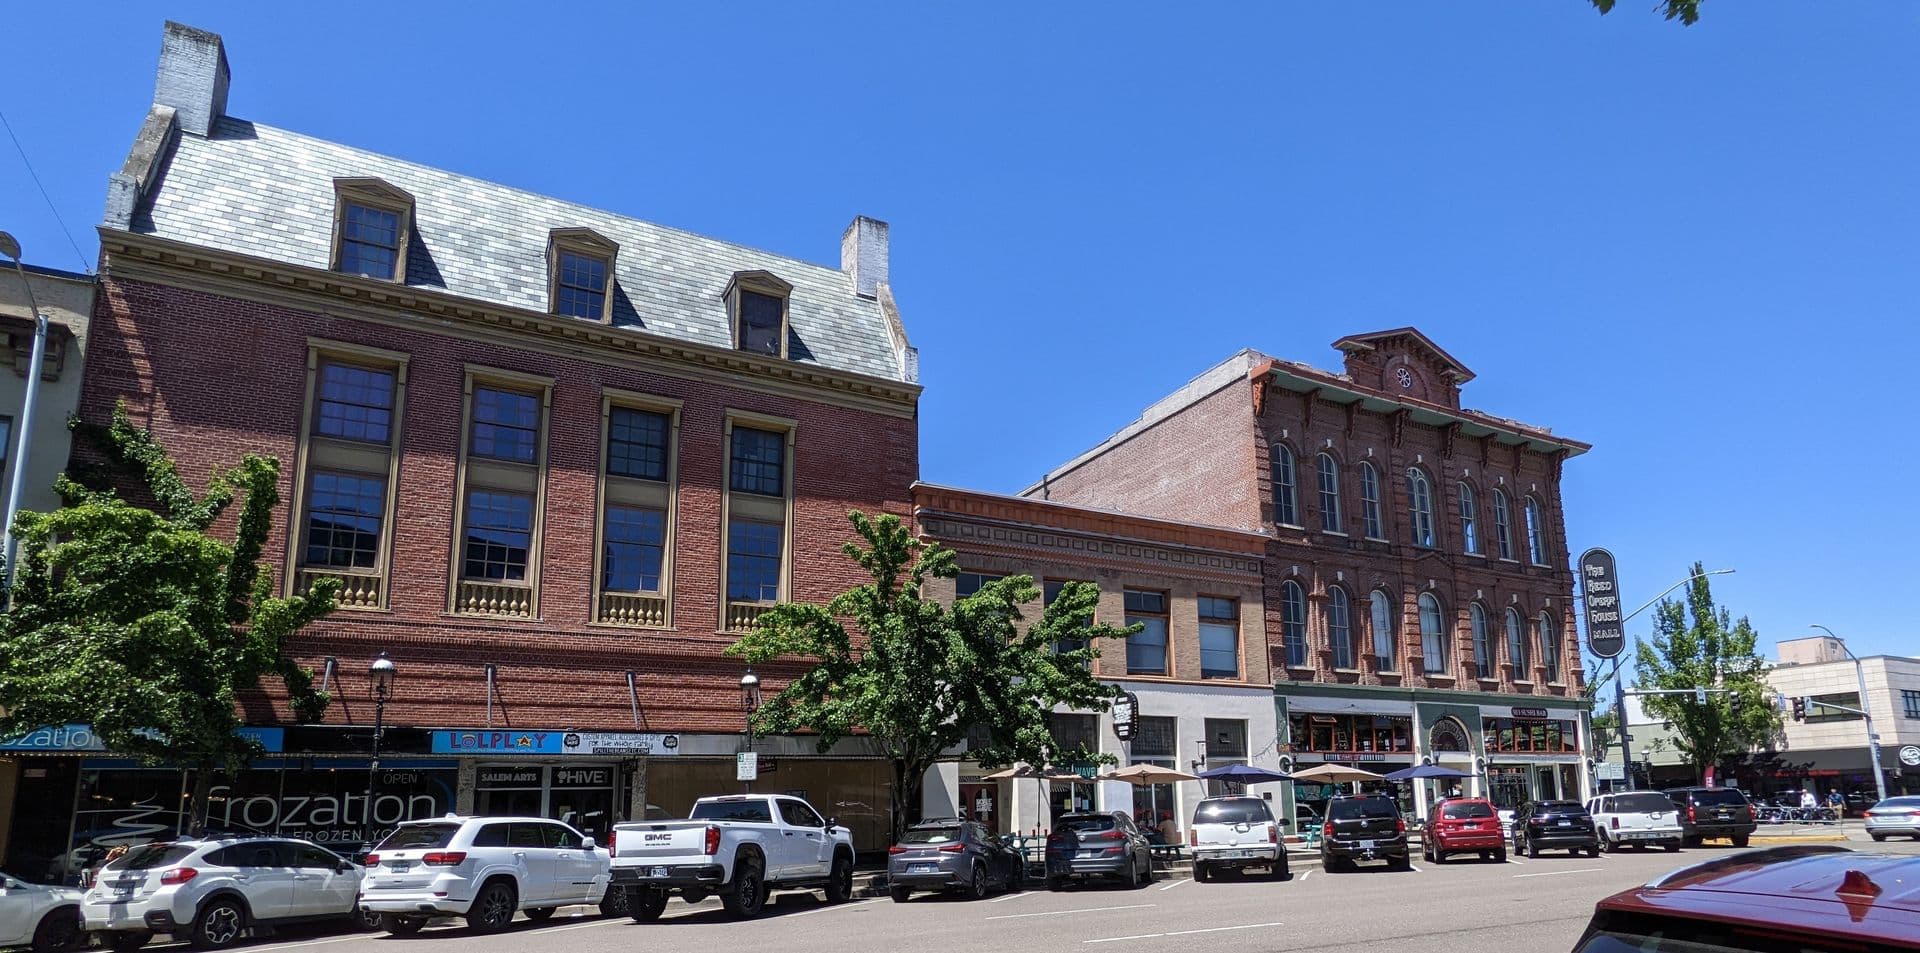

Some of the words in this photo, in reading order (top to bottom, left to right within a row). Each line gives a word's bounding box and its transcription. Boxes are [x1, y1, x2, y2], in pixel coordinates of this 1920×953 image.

[450, 732, 547, 749] LOLPLAY
[383, 773, 418, 785] OPEN
[482, 773, 511, 782] SALEM
[513, 773, 537, 782] ARTS
[204, 785, 436, 829] frozation
[294, 829, 363, 842] FROZEN
[644, 833, 672, 842] GMC
